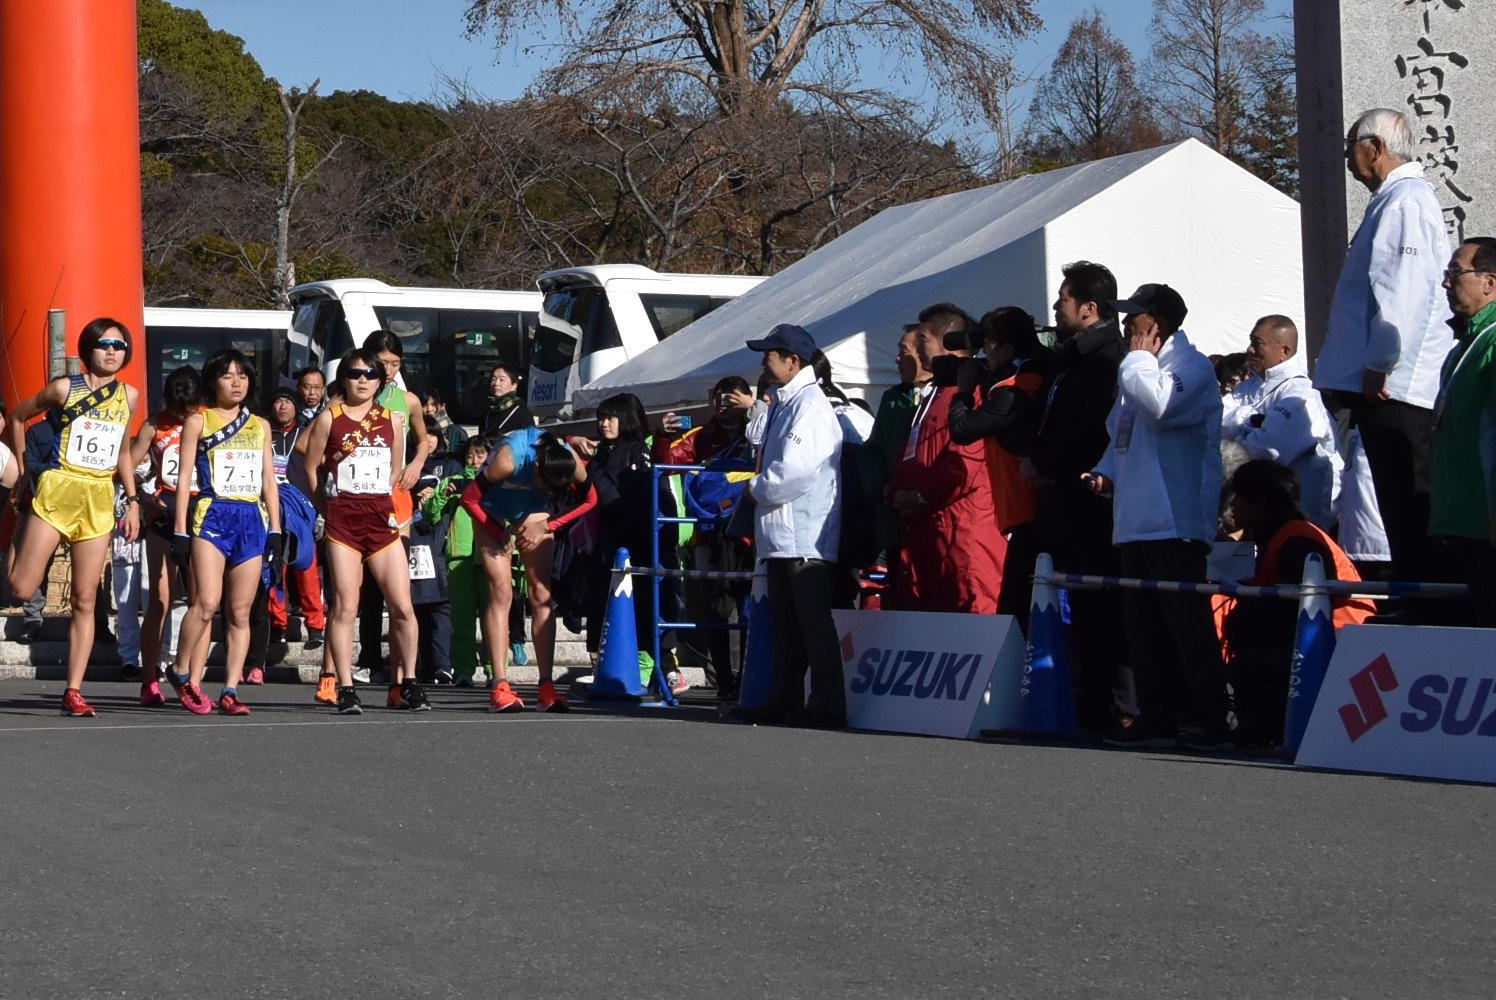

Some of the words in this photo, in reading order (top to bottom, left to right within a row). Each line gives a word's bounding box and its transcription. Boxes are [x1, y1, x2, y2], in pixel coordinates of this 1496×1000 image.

[1399, 246, 1419, 256] 201
[84, 408, 127, 423] 西大学
[93, 422, 117, 433] アルト
[787, 432, 802, 445] 018
[75, 434, 116, 457] 16-1
[236, 452, 257, 460] アルト
[359, 449, 382, 458] アルト
[81, 455, 107, 467] 城西大
[223, 465, 255, 482] 7-1
[348, 463, 381, 480] 1-1
[222, 484, 258, 493] 大阪学院大
[352, 482, 377, 491] 名城大
[850, 647, 984, 702] SUZUKI
